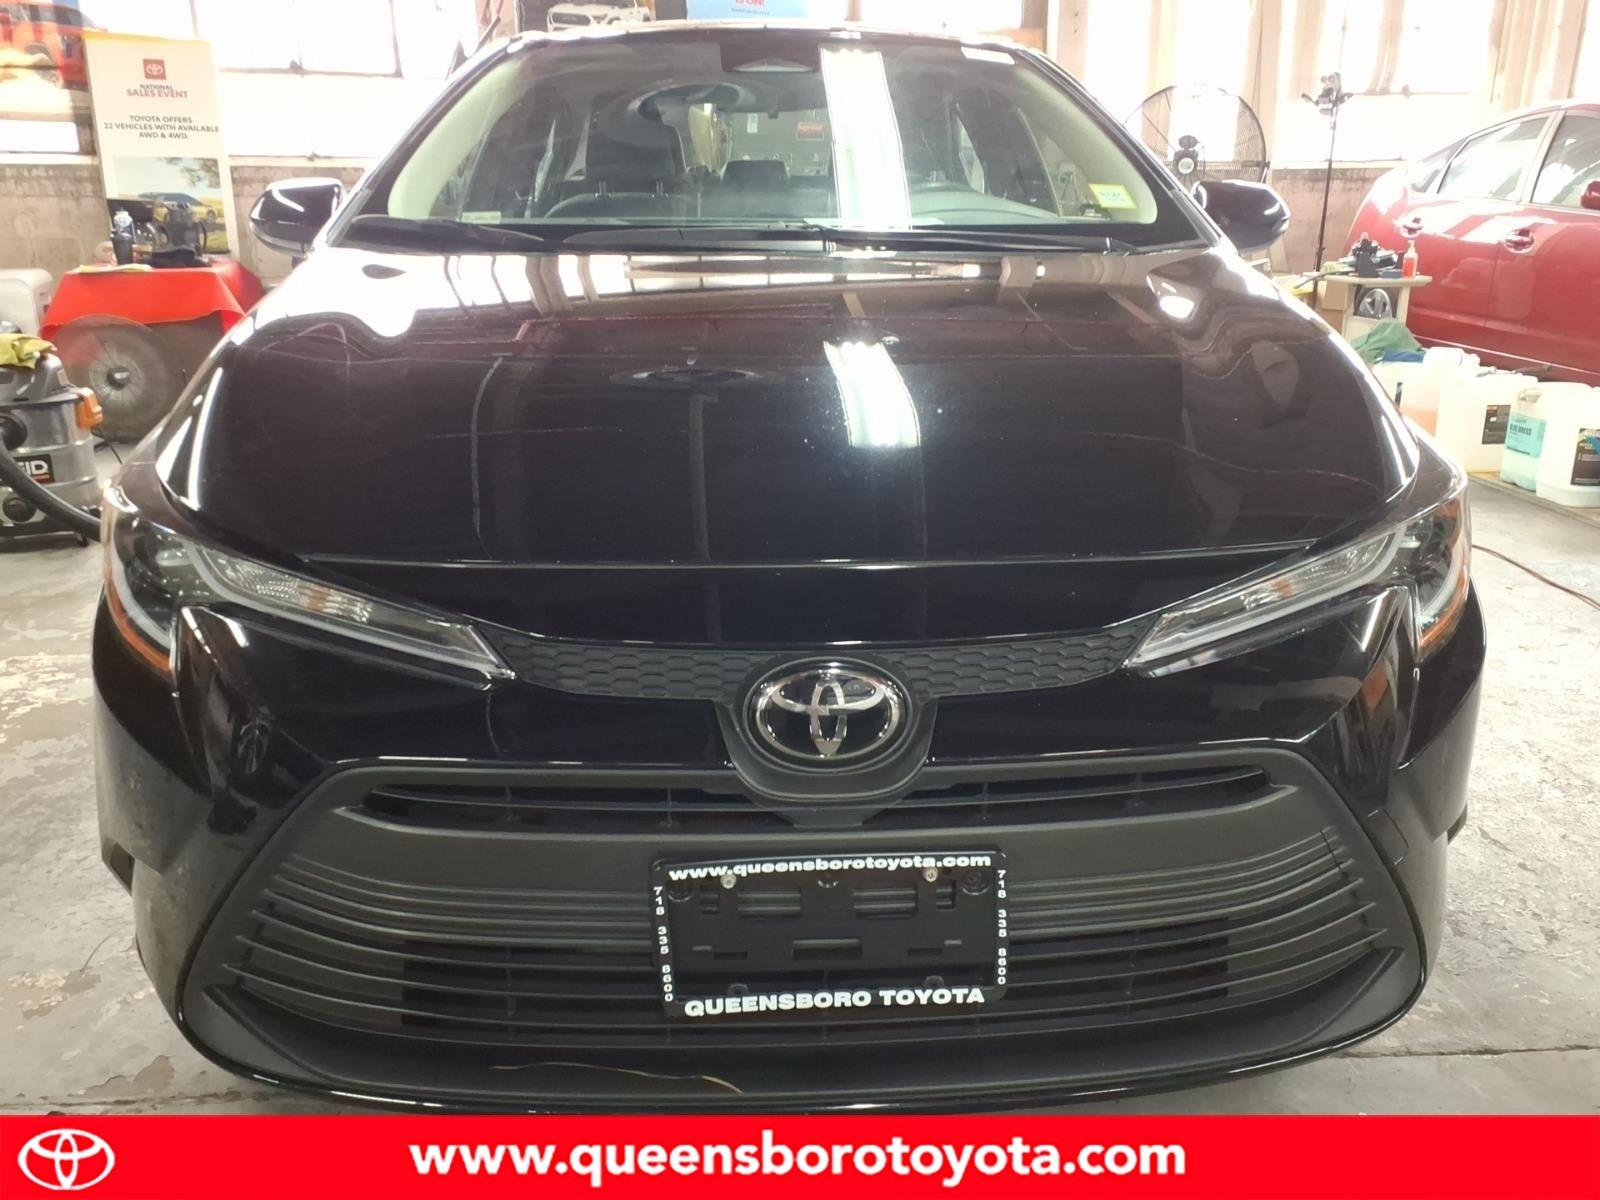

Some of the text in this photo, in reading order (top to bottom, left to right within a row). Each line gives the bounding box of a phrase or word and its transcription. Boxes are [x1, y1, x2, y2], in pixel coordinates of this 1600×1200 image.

[127, 89, 188, 98] SALES EVENT
[115, 123, 153, 131] VEHICLES
[178, 125, 220, 133] AVAILABLE
[129, 115, 161, 123] TOYOTA
[668, 855, 992, 881] www.queensborotoyota.com
[997, 869, 1007, 985] 718 335 8600
[653, 886, 674, 1002] 718 335 8600
[684, 988, 985, 1017] QUEENSBORO TOYOTA
